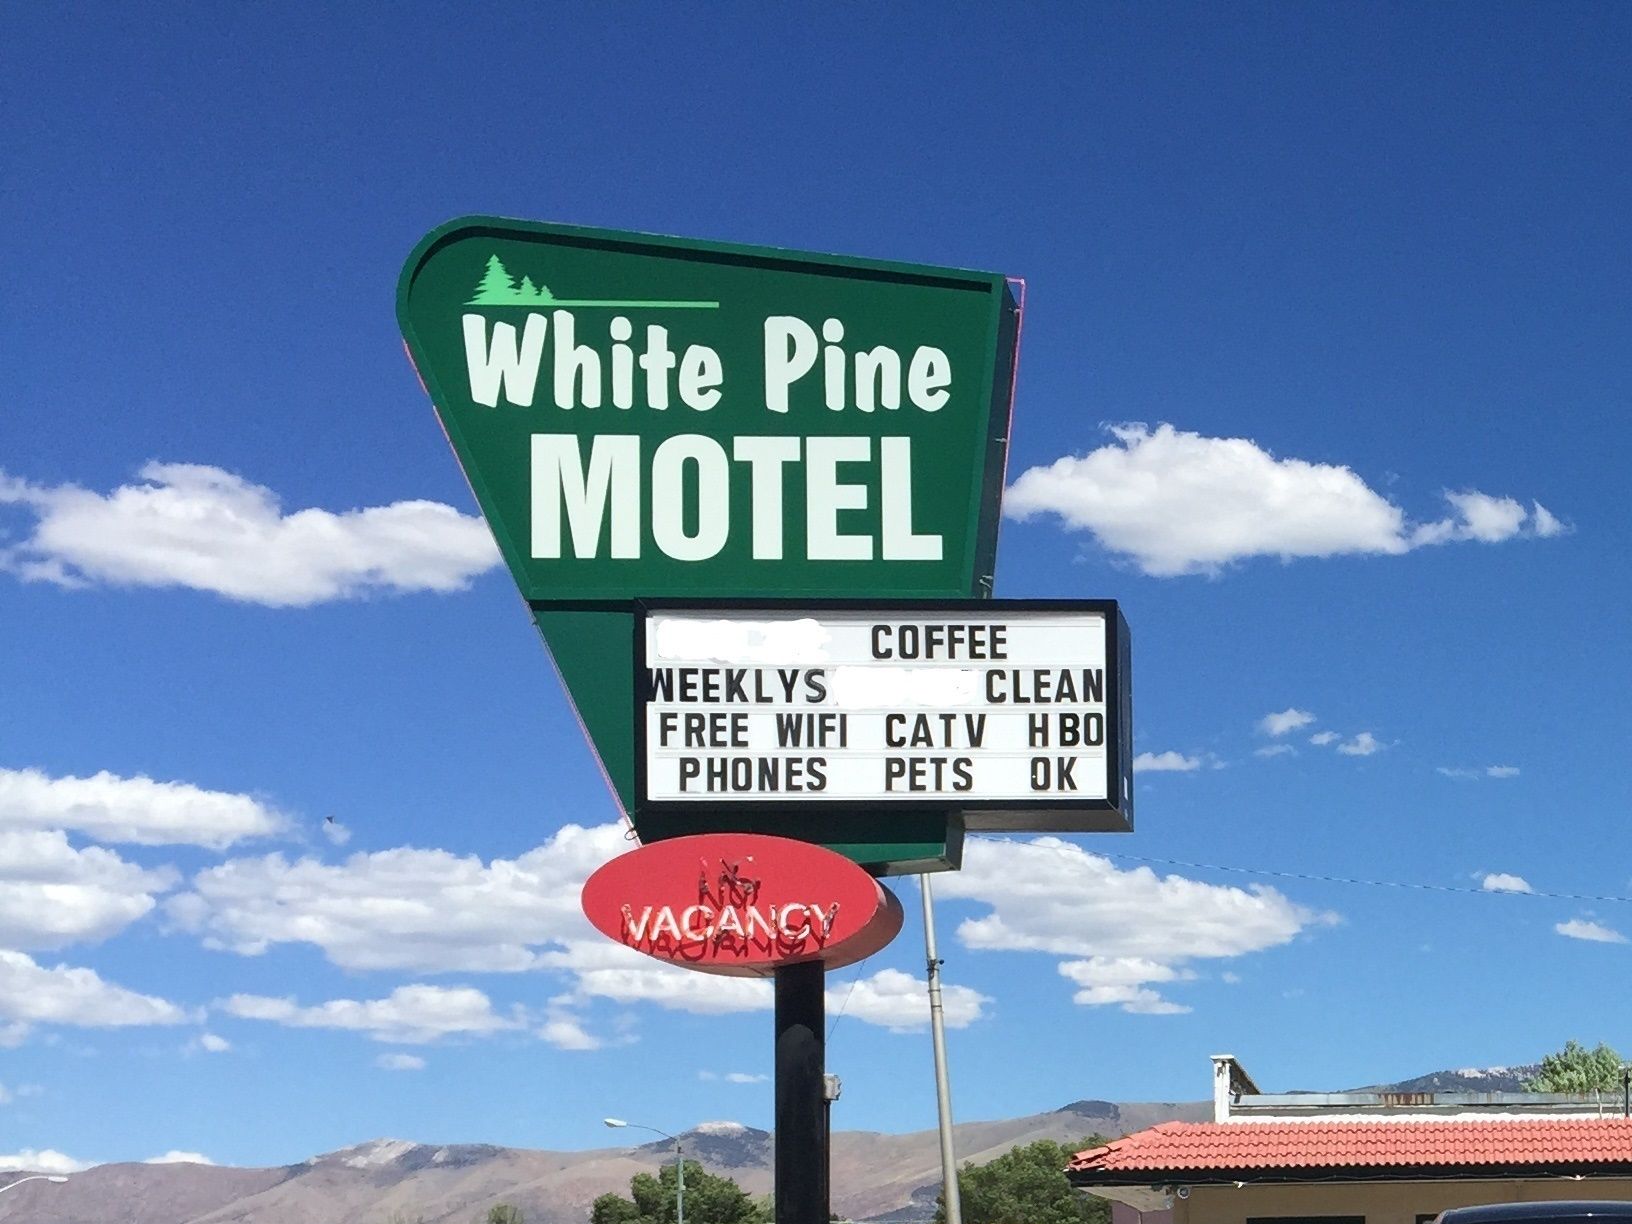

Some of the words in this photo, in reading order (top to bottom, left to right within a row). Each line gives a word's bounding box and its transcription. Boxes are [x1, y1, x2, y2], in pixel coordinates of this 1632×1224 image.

[462, 309, 724, 410] White
[763, 315, 952, 413] Pine
[529, 433, 944, 562] MOTEL
[871, 624, 1007, 660] COFFEE
[648, 667, 828, 704] WEEKLYS
[985, 668, 1104, 704] CLEAN
[659, 712, 749, 748] FREE
[776, 712, 848, 748] WIFI
[885, 712, 987, 748] CATV
[1028, 712, 1104, 748] HBO
[679, 756, 828, 793] PHONES
[885, 756, 973, 792] PETS
[1030, 756, 1078, 792] OK
[620, 901, 840, 942] VACANCY
